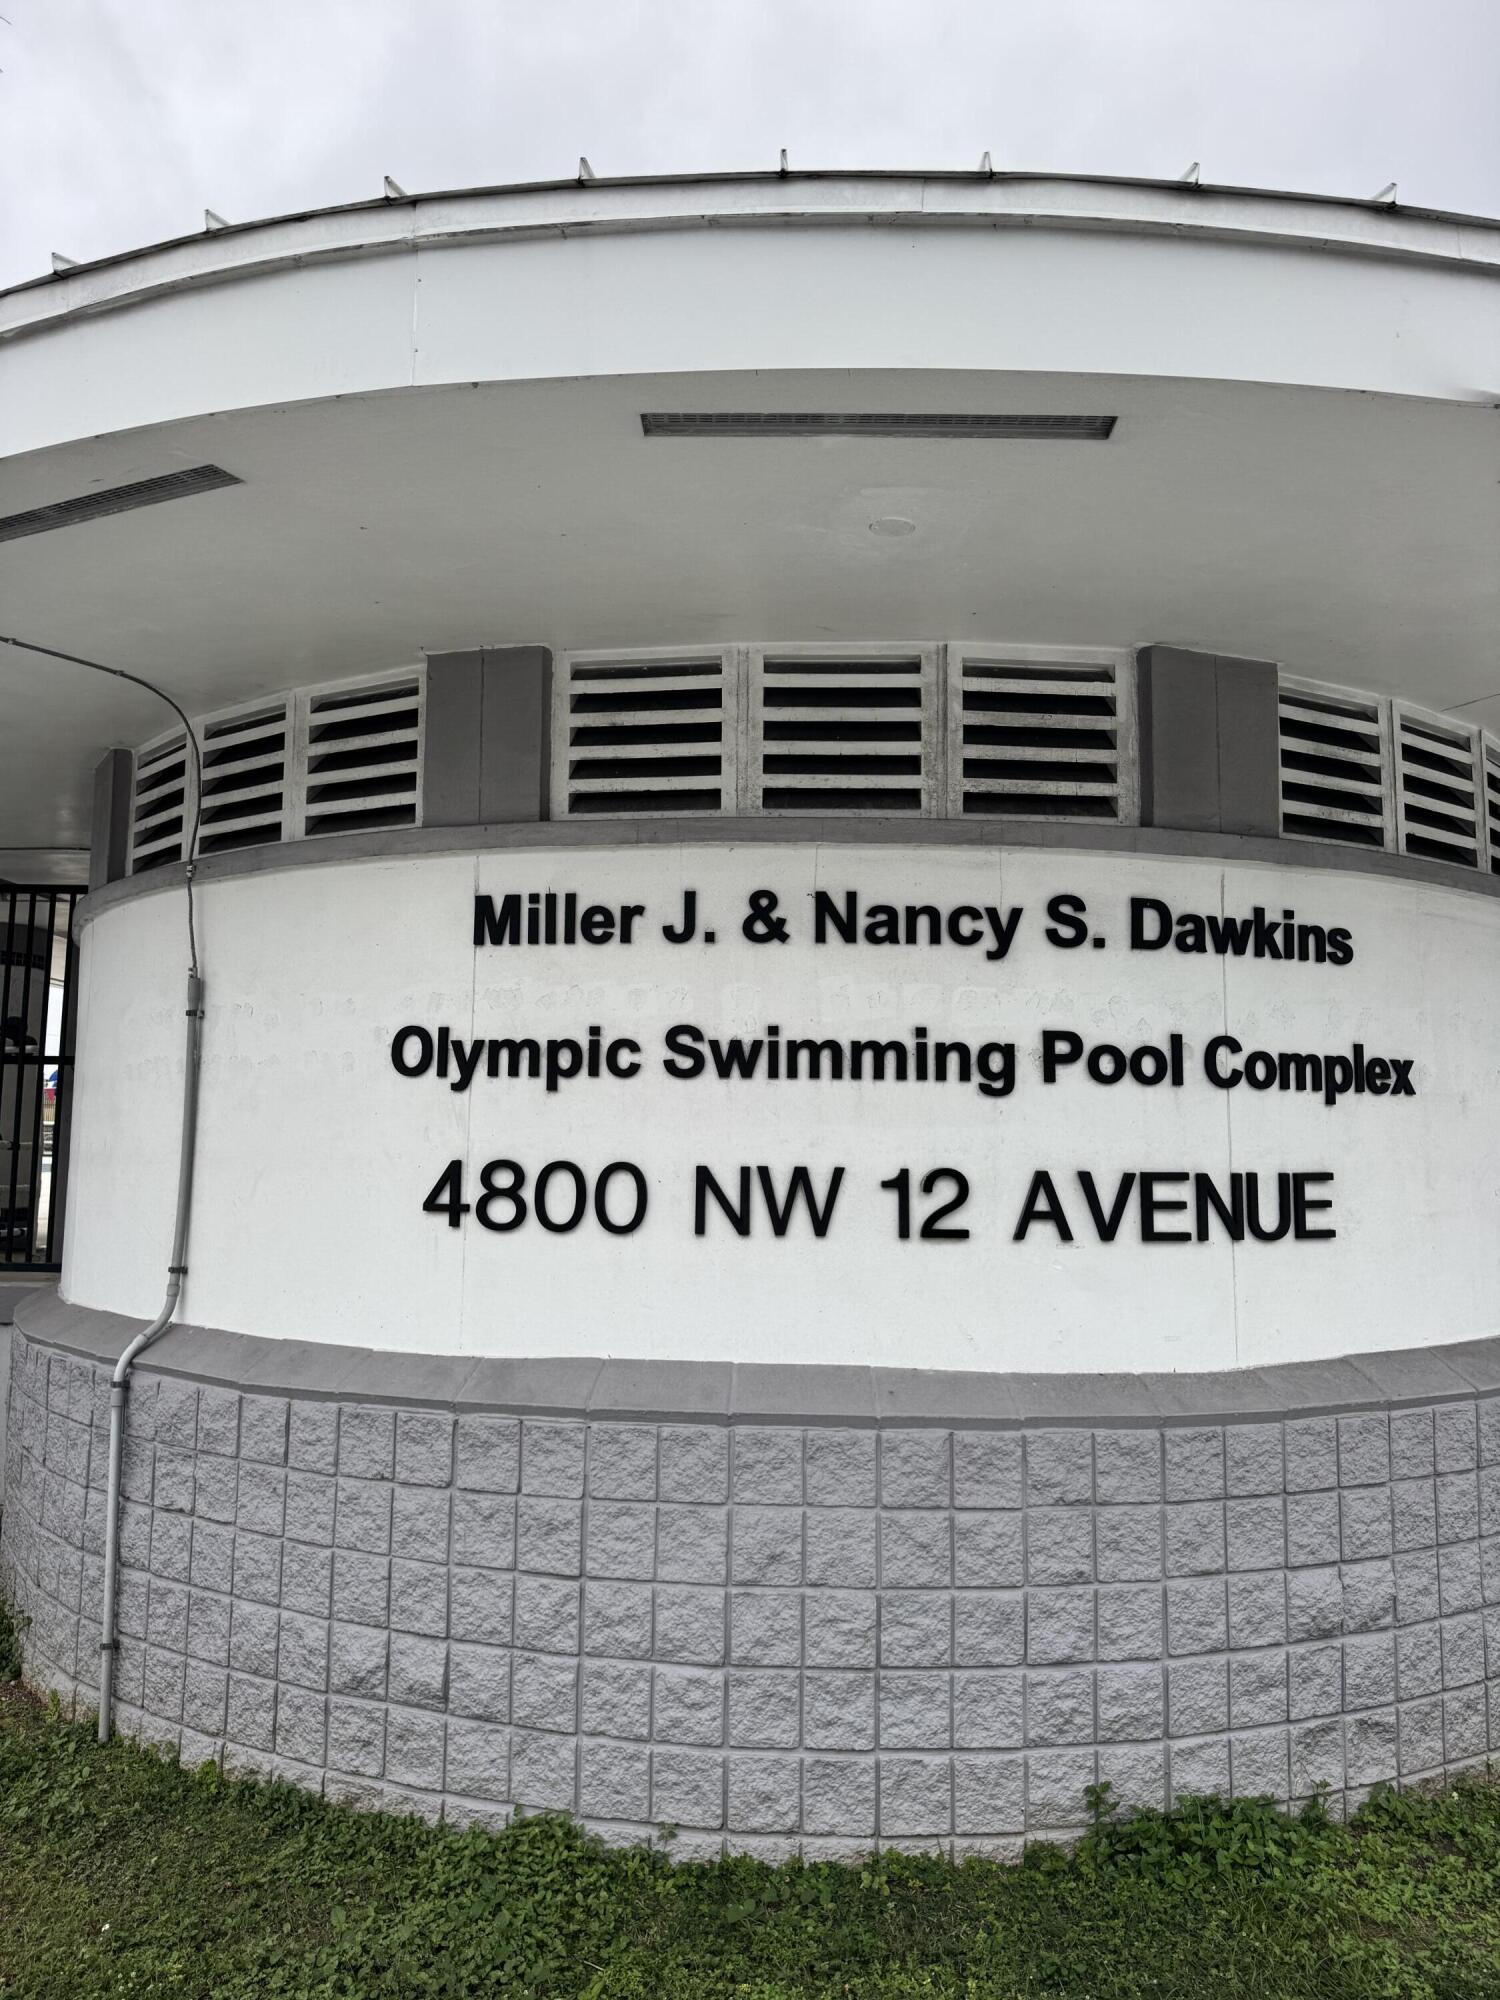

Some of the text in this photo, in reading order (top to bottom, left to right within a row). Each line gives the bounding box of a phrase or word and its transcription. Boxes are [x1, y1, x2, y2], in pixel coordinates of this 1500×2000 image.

[473, 889, 1354, 967] Miller J. & Nancy S. Dawkins
[391, 1024, 1417, 1107] Olympic Swimming Pool Complex
[422, 1158, 1337, 1244] 4800 NW 12 AVENUE
